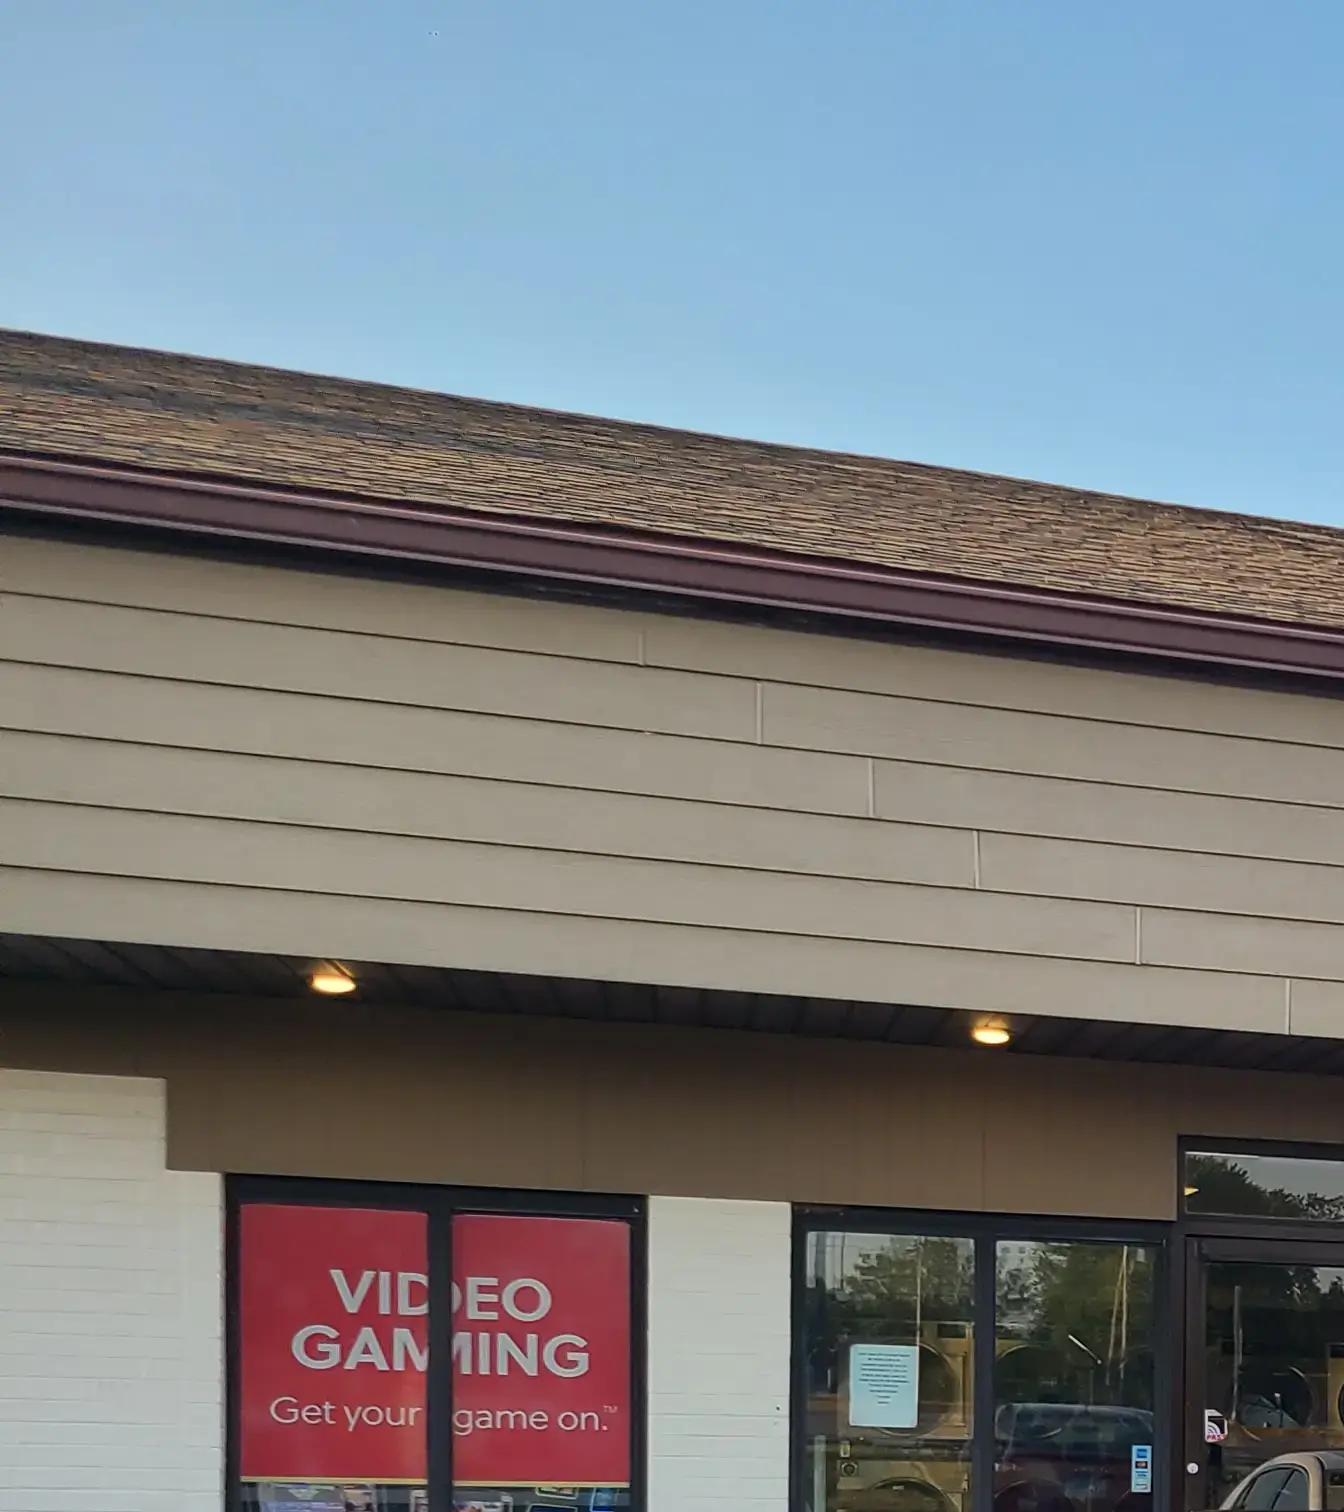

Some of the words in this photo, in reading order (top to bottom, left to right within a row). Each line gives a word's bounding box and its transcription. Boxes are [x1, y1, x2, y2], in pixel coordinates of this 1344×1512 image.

[330, 1269, 552, 1322] VIDEO
[291, 1325, 590, 1378] GAMING
[269, 1396, 336, 1426] Get
[343, 1403, 421, 1433] your
[452, 1406, 549, 1436] game
